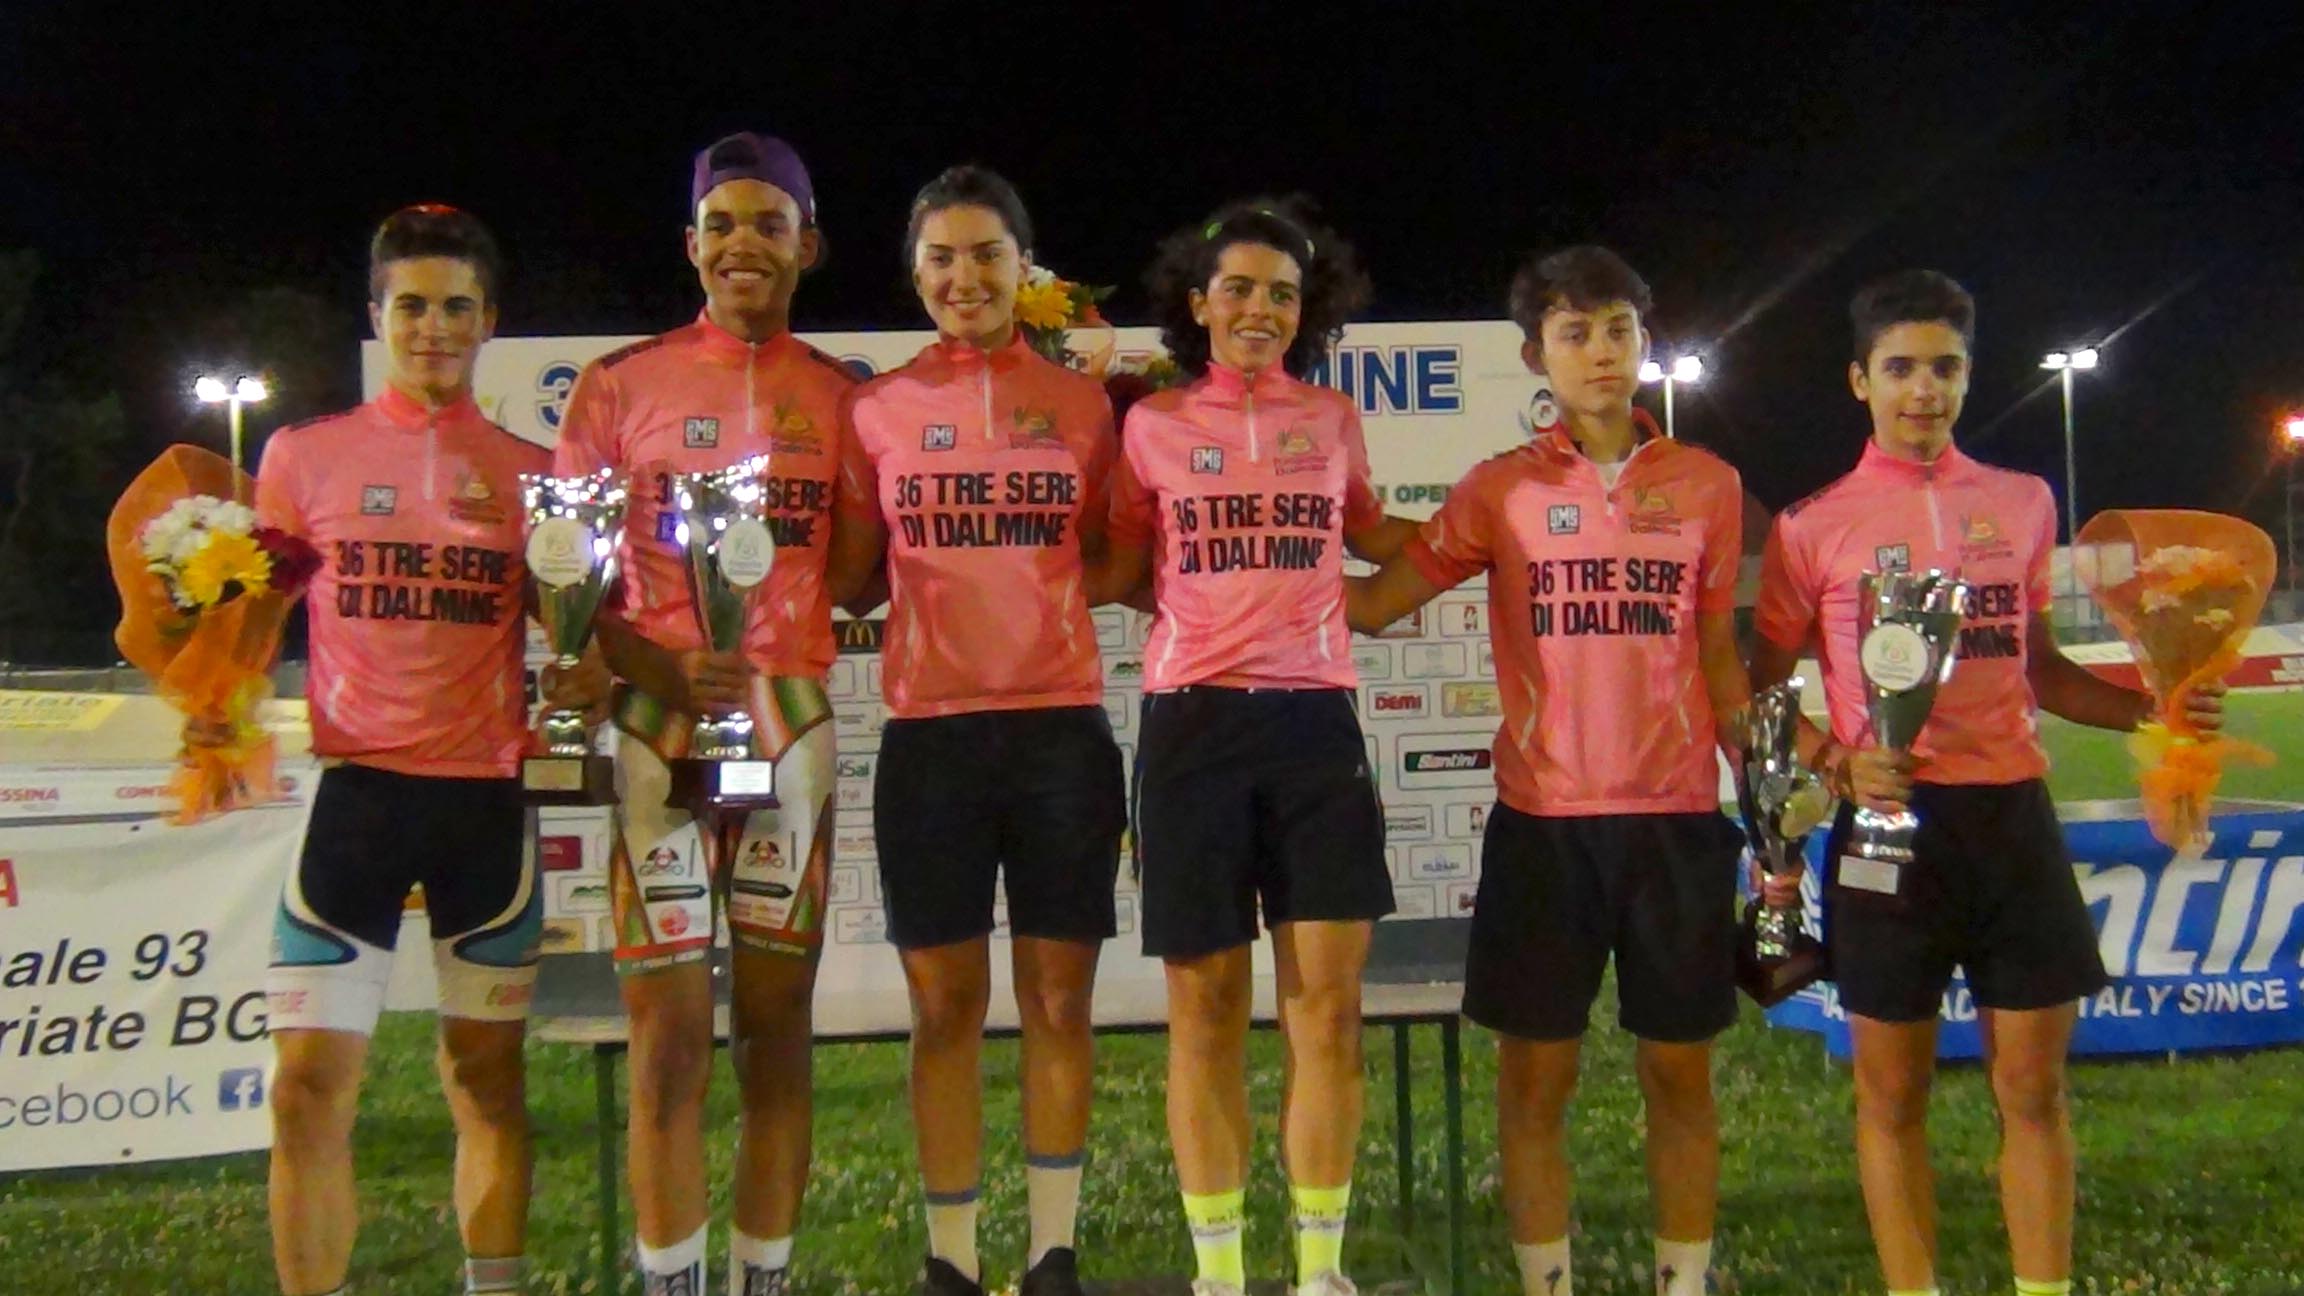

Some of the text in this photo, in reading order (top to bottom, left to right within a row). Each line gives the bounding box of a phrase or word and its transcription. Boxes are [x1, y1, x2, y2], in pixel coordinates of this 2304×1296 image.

[896, 471, 1077, 509] 36 TRE SERE
[899, 511, 1070, 548] DI DALMINE
[1203, 493, 1263, 529] TRE
[337, 541, 364, 577] 36
[373, 541, 433, 578] TRE
[440, 545, 511, 585] SERE
[1528, 557, 1687, 598] 36 TRE SERE
[369, 584, 503, 627] DALMINE
[1531, 600, 1677, 637] DI DALMINE
[0, 930, 209, 988] ale 93
[2078, 978, 2289, 1018] TALY SINCE
[170, 992, 271, 1047] BG
